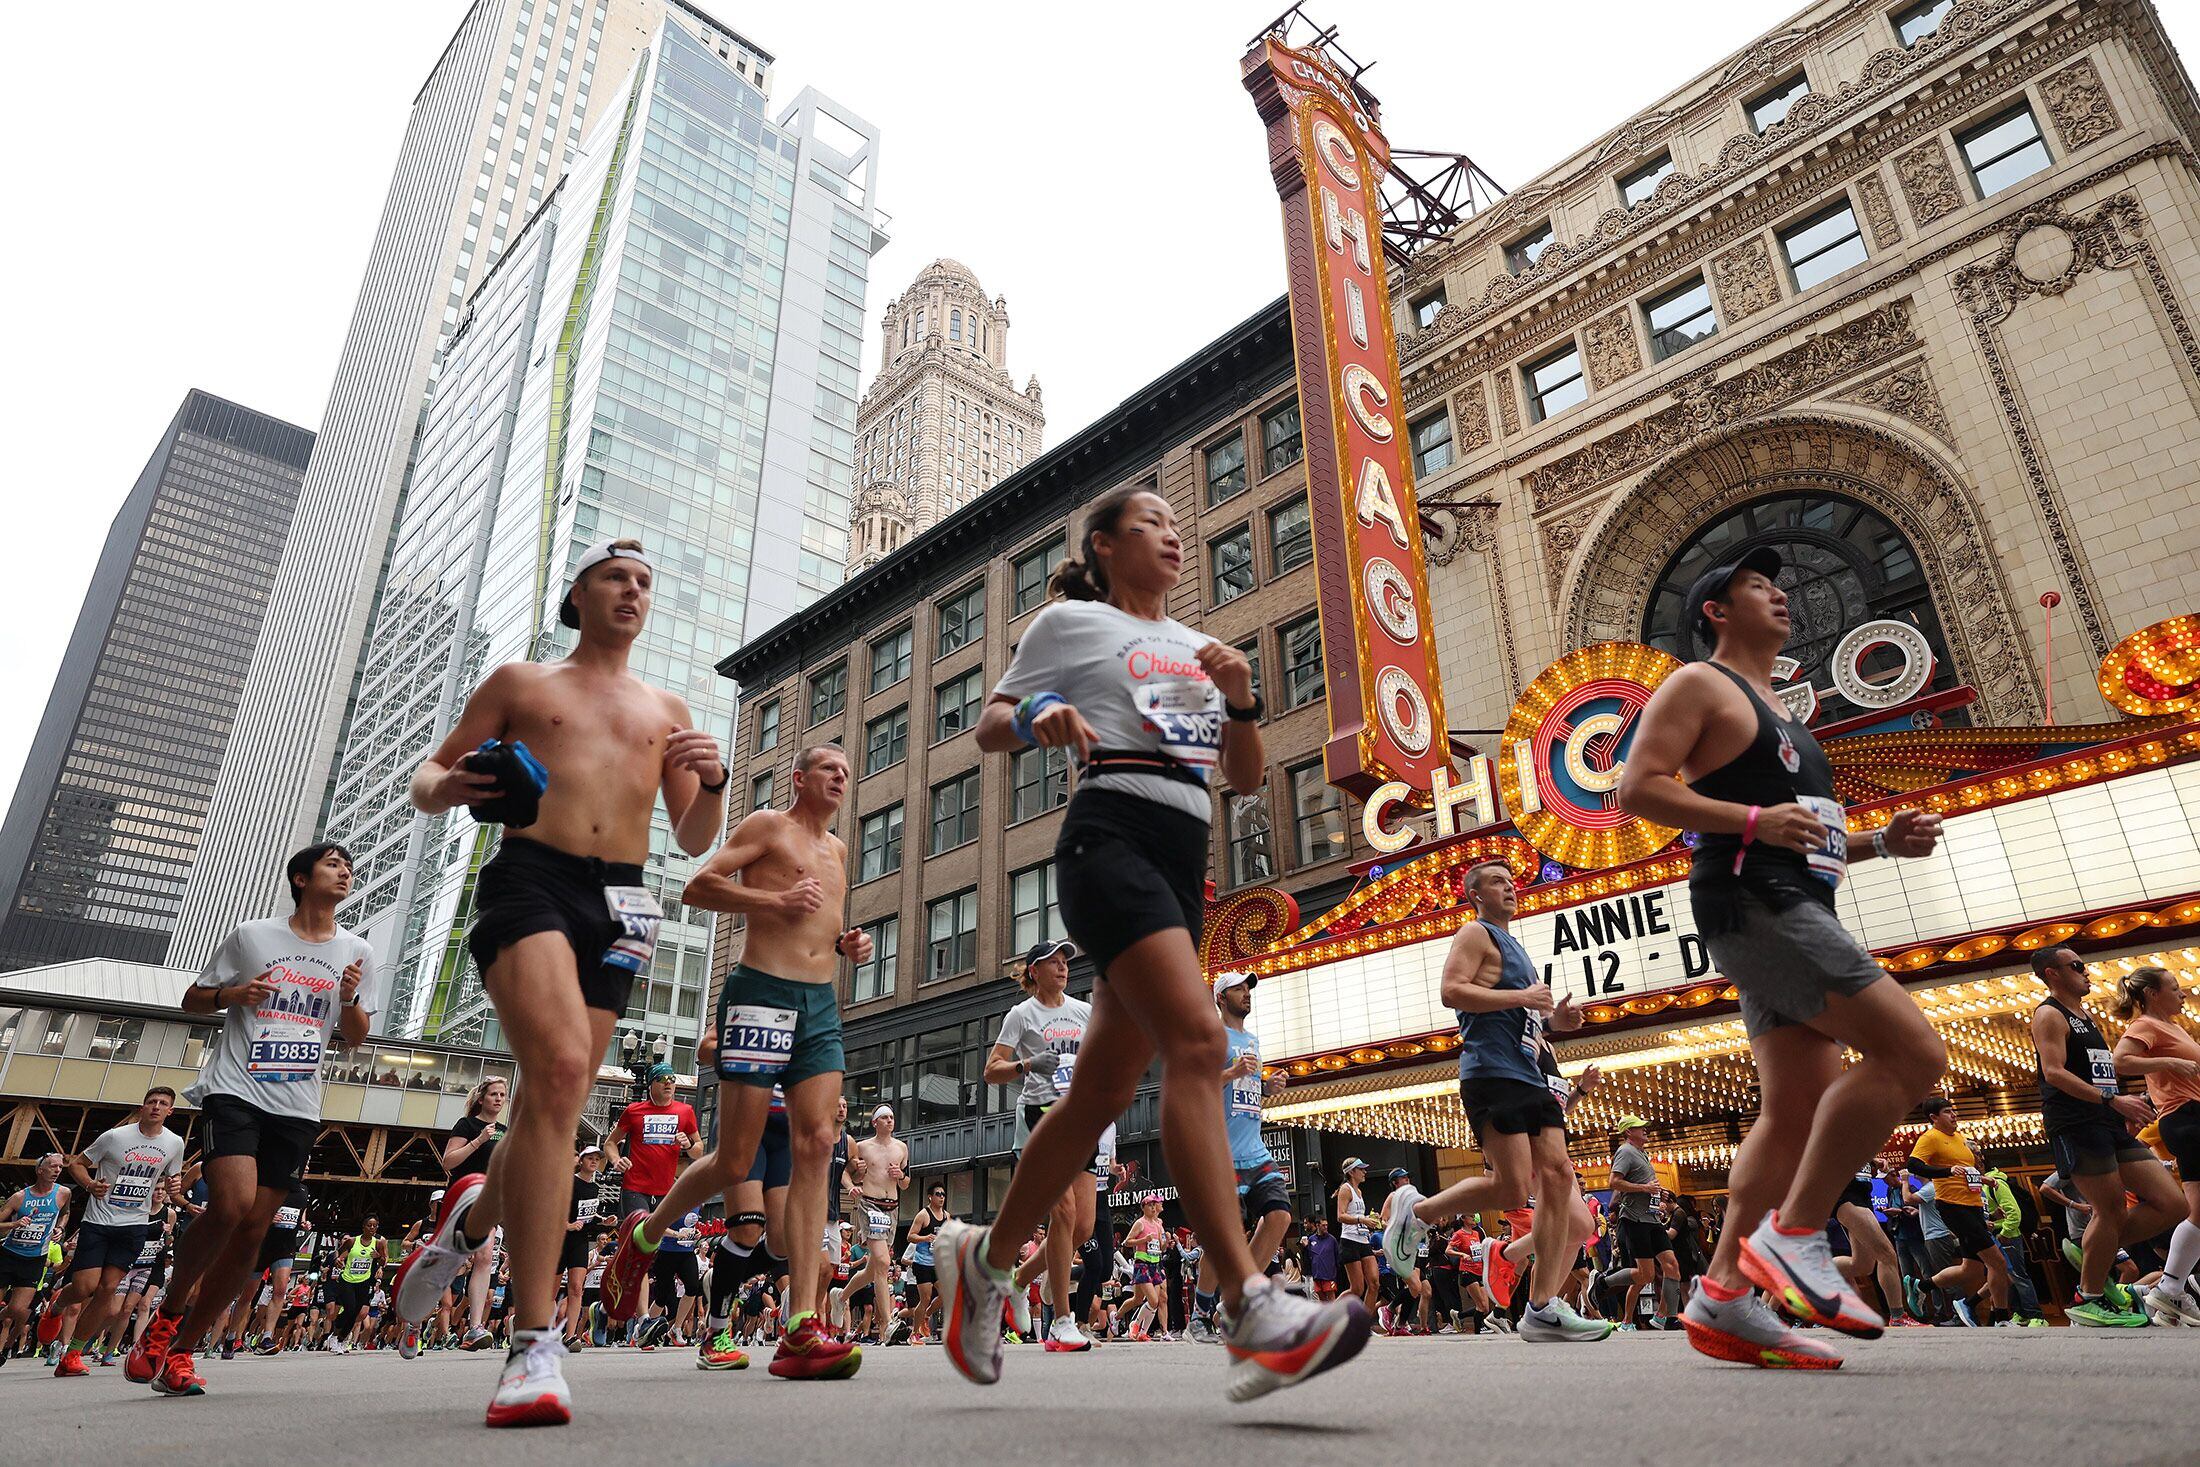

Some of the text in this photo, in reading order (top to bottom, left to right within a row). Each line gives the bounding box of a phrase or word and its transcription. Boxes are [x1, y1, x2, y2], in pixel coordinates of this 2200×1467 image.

[1291, 59, 1351, 111] CHASE
[1313, 120, 1433, 757] CHICAGO
[1128, 651, 1211, 682] Chicag
[1152, 714, 1180, 741] E
[1362, 619, 1932, 853] CHICO
[1553, 890, 1670, 956] ANNIE
[265, 955, 292, 969] BANK
[309, 957, 341, 982] AMERICA
[1583, 950, 1625, 997] 12
[266, 965, 335, 993] Chicago
[256, 1010, 314, 1025] MARATHON
[1525, 1019, 1531, 1034] E
[723, 1028, 793, 1050] E 12196
[1044, 1028, 1081, 1042] Chicago
[251, 1043, 319, 1060] E 19835
[1052, 1070, 1060, 1083] E
[2092, 1063, 2100, 1077] C
[1234, 1091, 1240, 1103] E
[644, 1124, 677, 1133] E 18847
[1263, 1131, 1289, 1147] RETAIL
[125, 1146, 139, 1154] BANK
[149, 1145, 166, 1157] AMERICA
[125, 1152, 162, 1165] Chicago
[113, 1185, 121, 1194] E
[25, 1198, 53, 1208] POLLY
[579, 1208, 583, 1216] E
[21, 1231, 43, 1240] 6348
